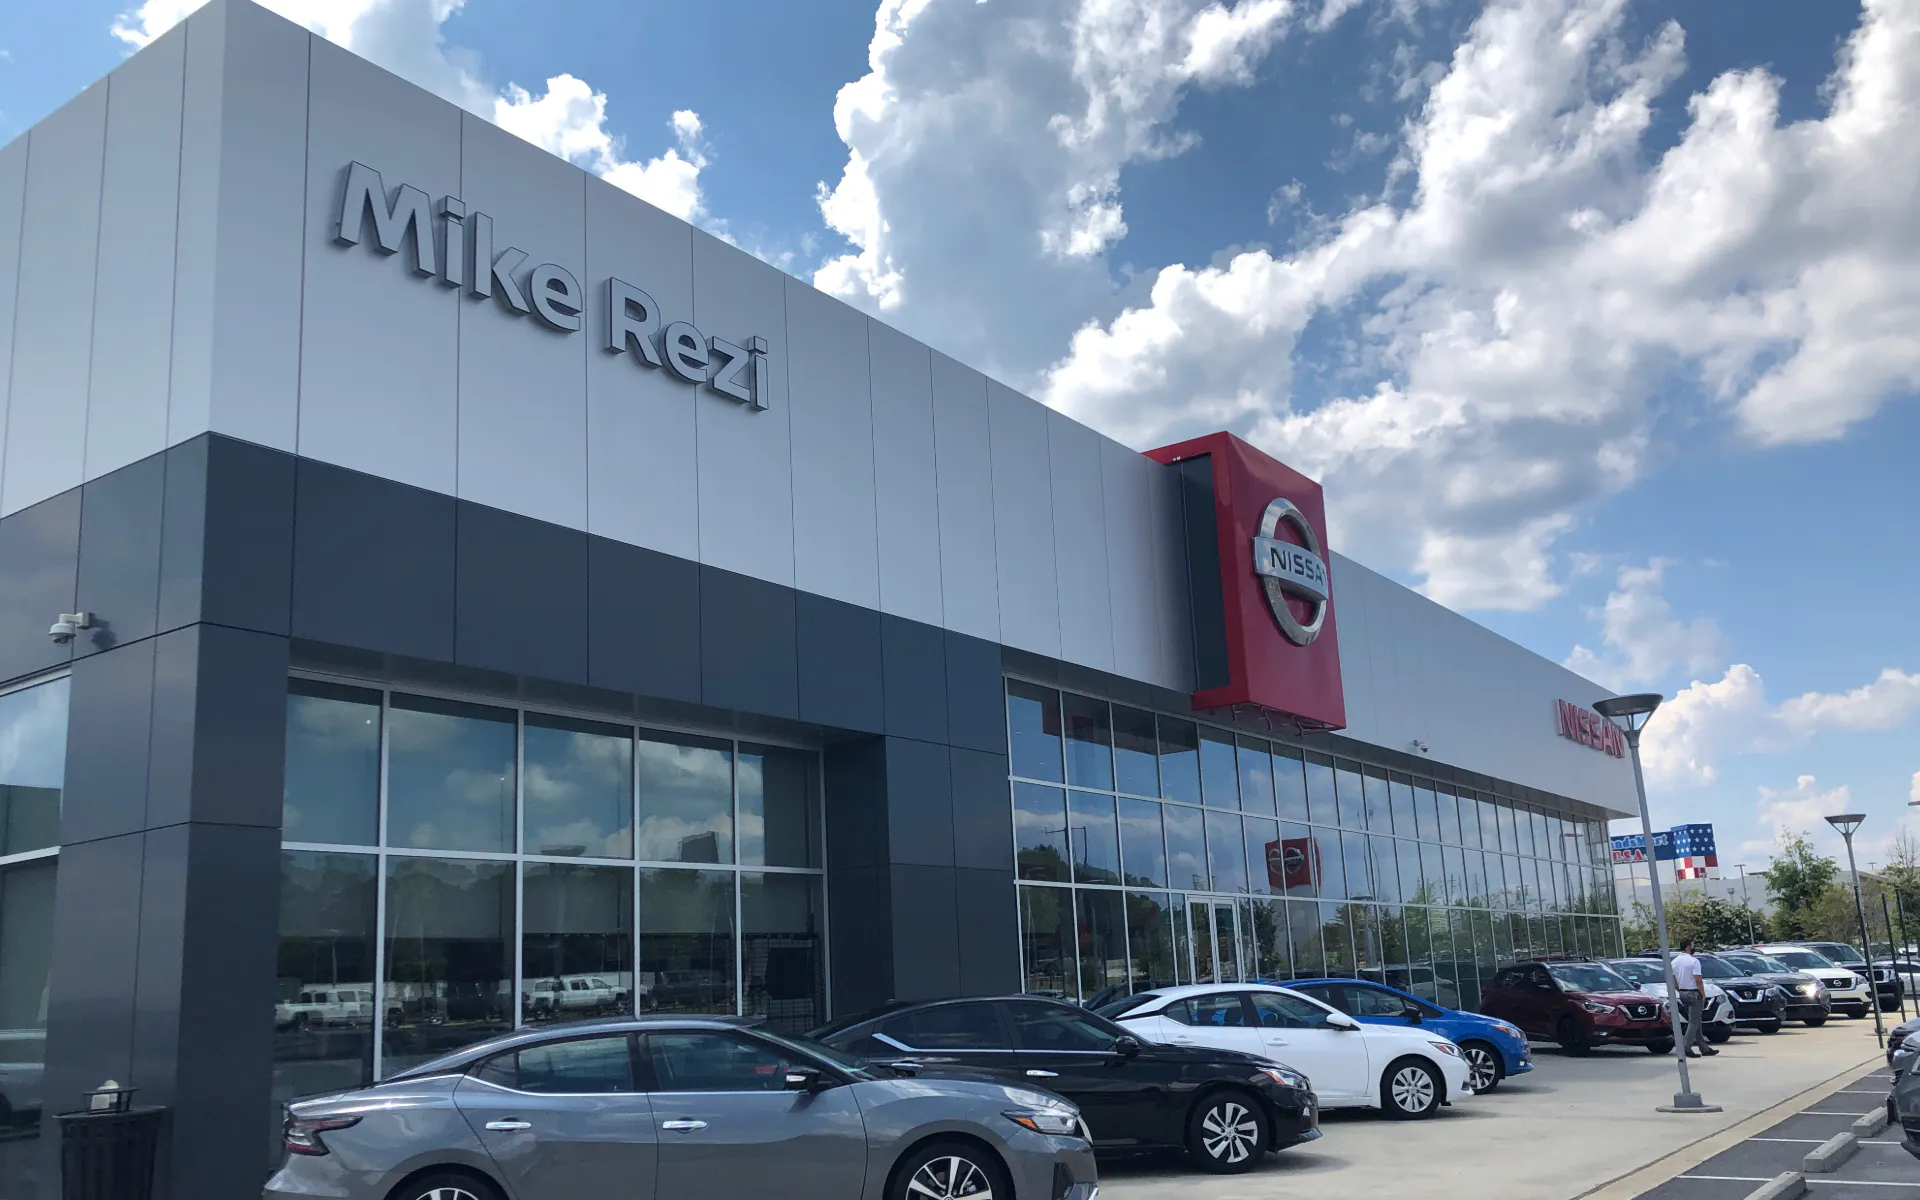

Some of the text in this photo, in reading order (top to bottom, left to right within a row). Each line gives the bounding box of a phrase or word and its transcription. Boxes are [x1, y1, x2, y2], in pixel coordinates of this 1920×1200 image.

[334, 160, 769, 412] Mike Rezi
[1556, 697, 1625, 759] NISSAN
